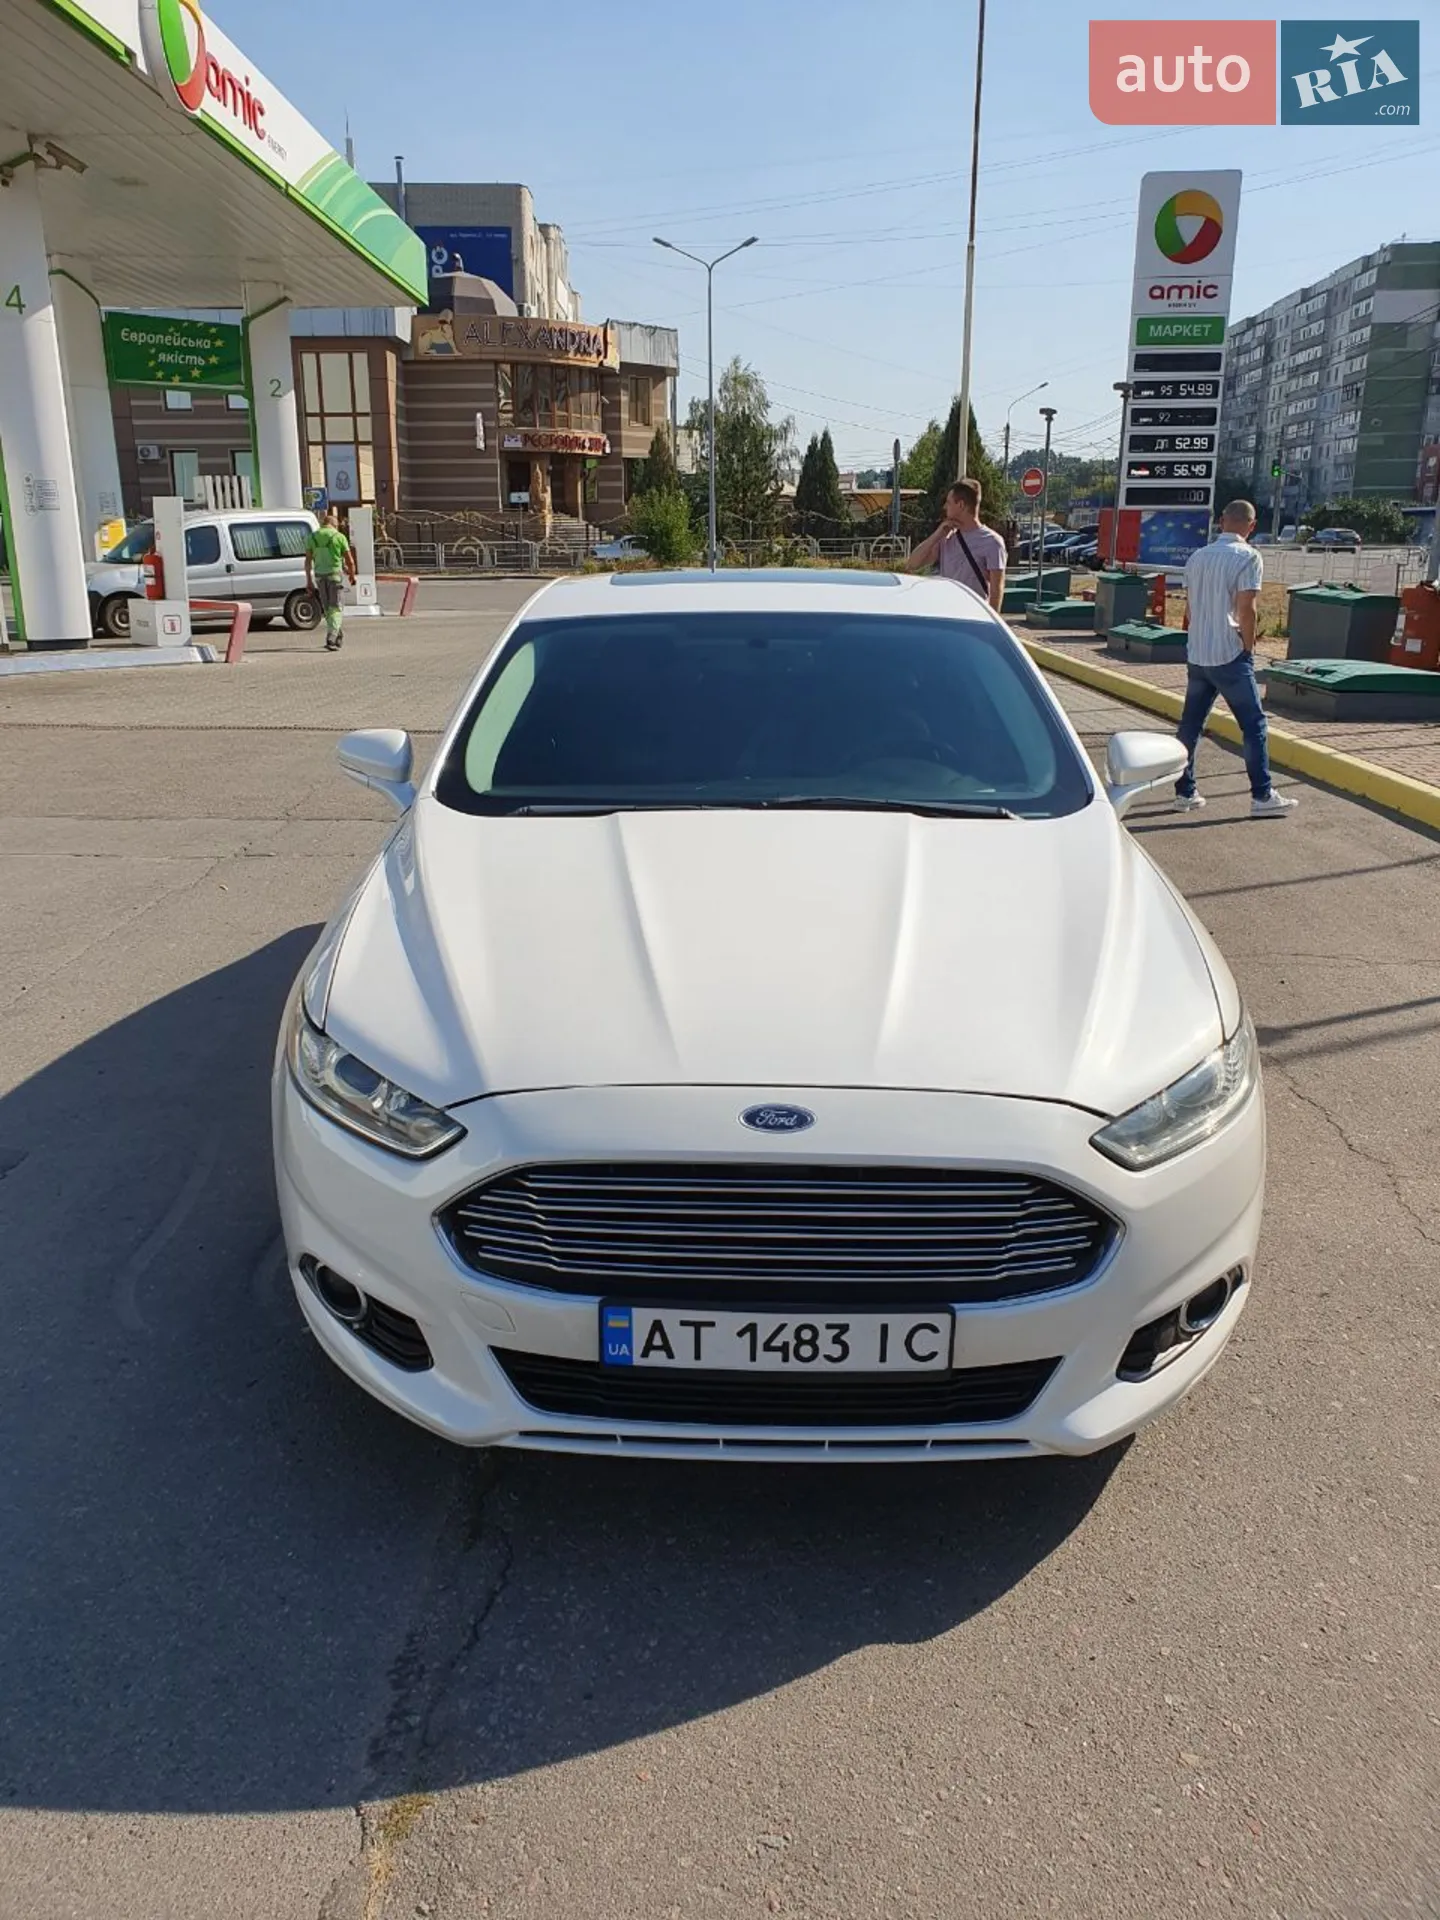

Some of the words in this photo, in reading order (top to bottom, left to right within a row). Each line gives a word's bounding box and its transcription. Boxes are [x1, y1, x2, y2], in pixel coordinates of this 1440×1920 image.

[205, 51, 266, 140] amic
[1148, 280, 1219, 300] amic
[5, 284, 26, 315] 4
[121, 327, 211, 349] Європейська
[1149, 323, 1212, 337] МАРКЕТ
[157, 350, 206, 366] якість
[269, 378, 283, 398] 2
[1179, 383, 1213, 396] 54.99
[1175, 437, 1209, 450] 52.99
[1173, 463, 1207, 477] 56.49
[755, 1109, 799, 1126] Ford
[640, 1318, 716, 1362] AT
[735, 1321, 851, 1364] 1483
[879, 1321, 941, 1364] IC
[607, 1343, 630, 1357] UA
